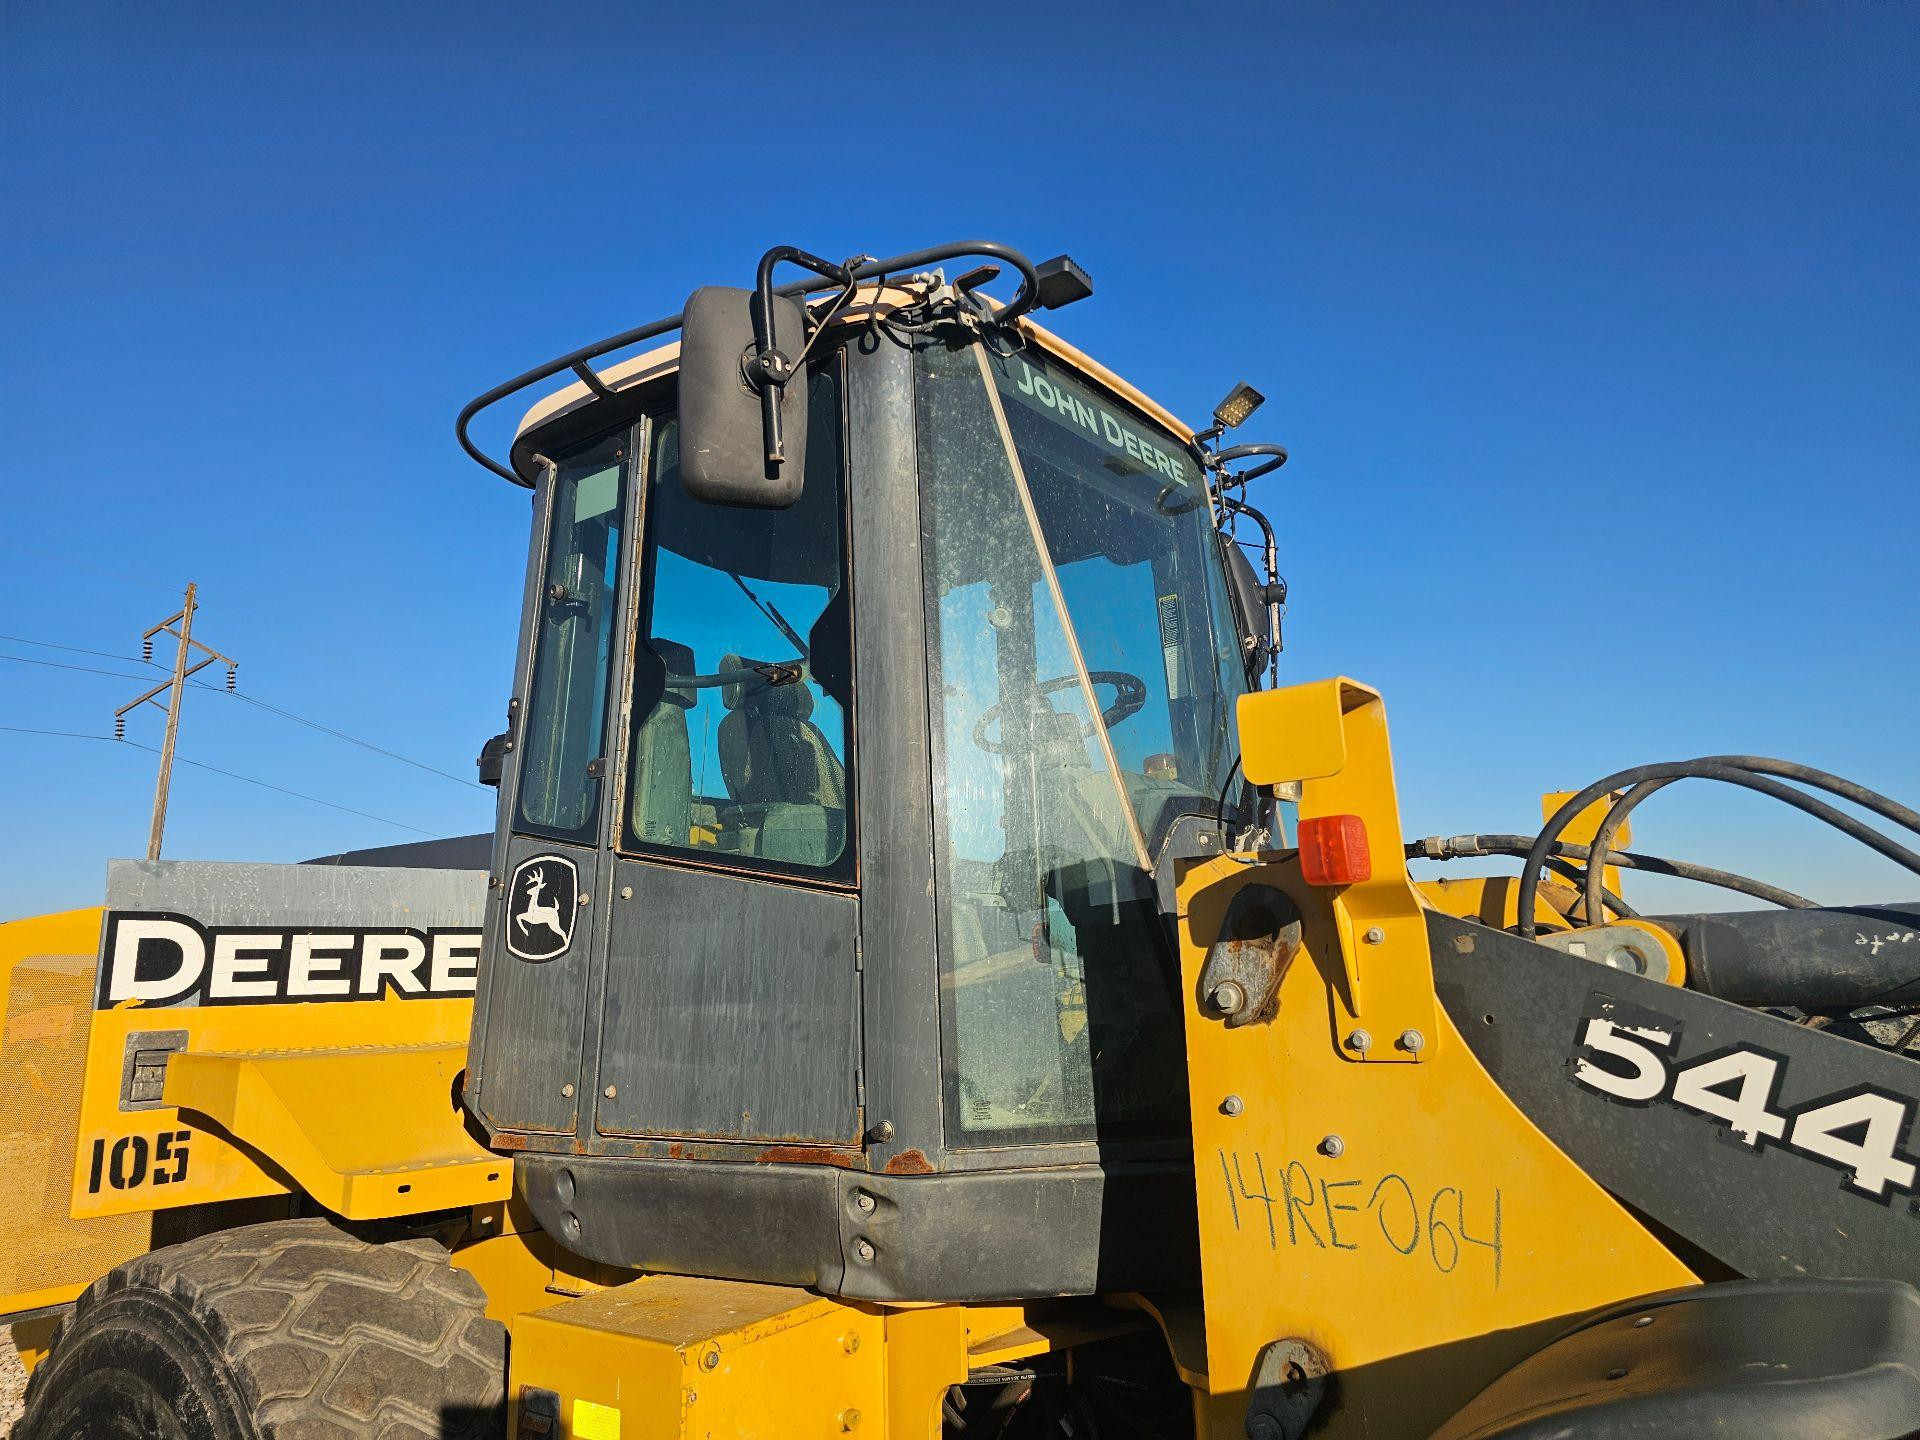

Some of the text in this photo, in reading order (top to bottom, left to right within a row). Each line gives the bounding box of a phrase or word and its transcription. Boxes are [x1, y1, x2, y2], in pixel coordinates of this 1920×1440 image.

[1017, 361, 1188, 488] JOHN DEERE
[88, 1130, 192, 1194] 105
[1573, 1016, 1916, 1195] 544
